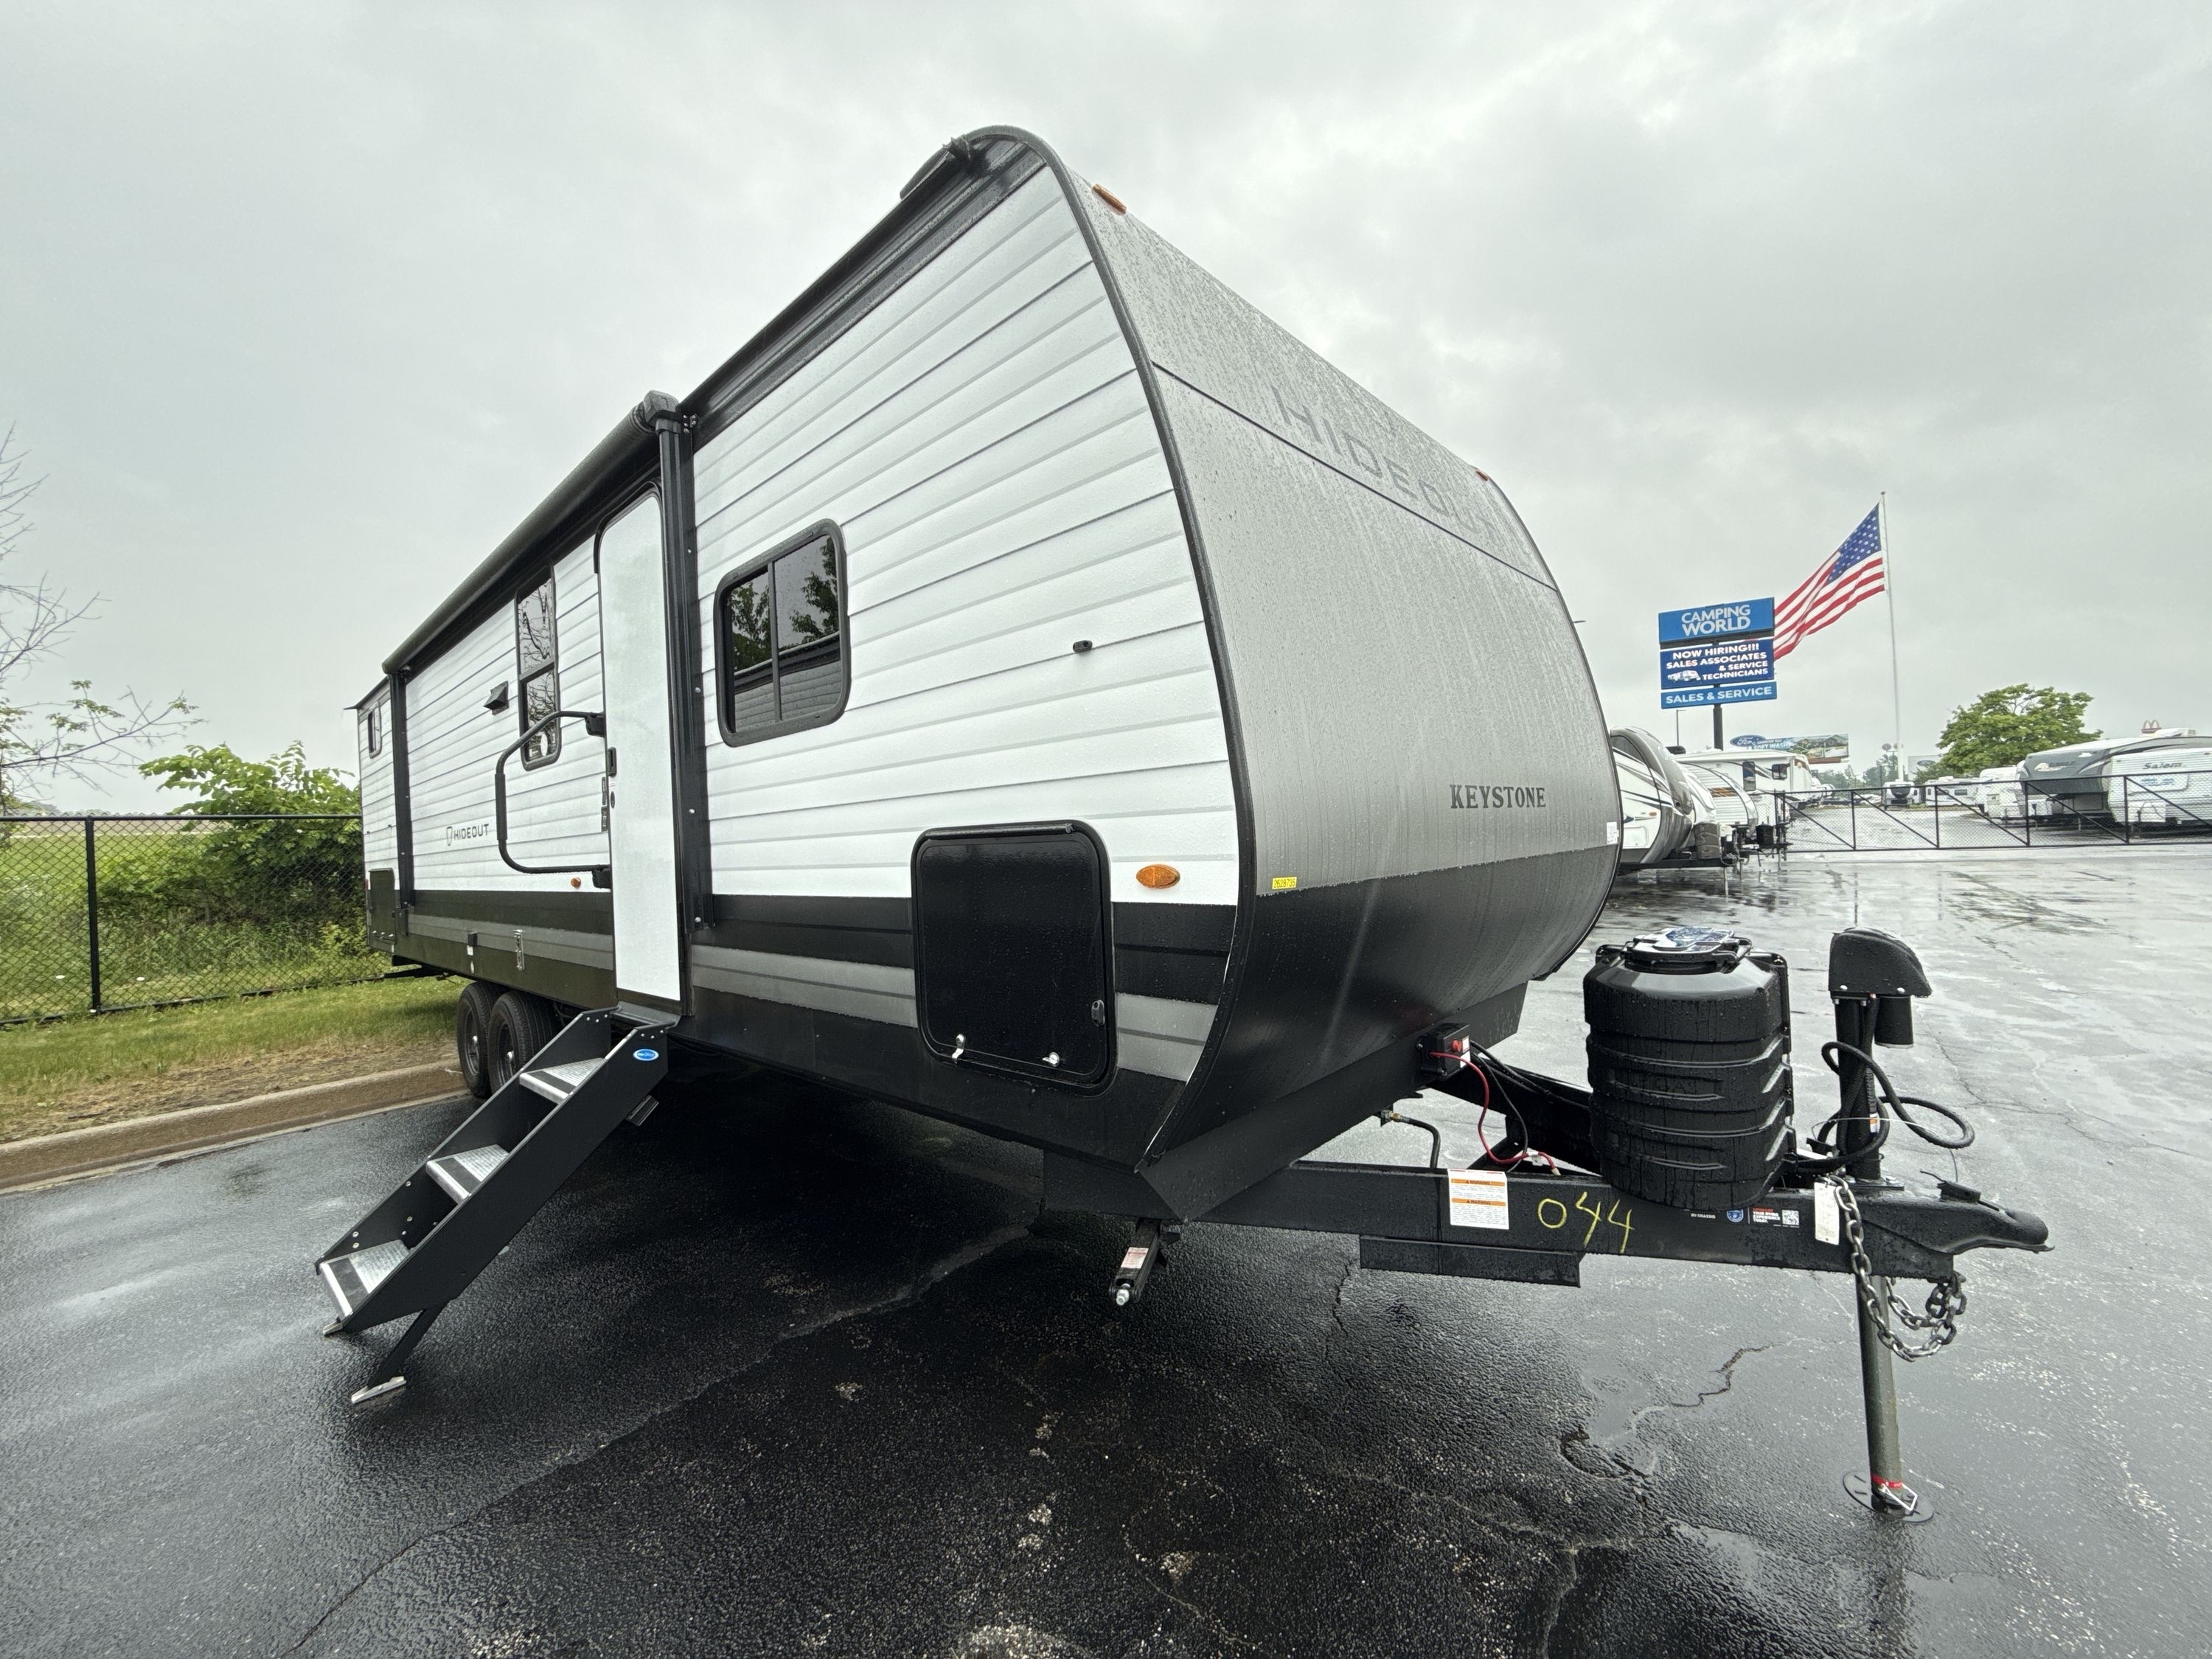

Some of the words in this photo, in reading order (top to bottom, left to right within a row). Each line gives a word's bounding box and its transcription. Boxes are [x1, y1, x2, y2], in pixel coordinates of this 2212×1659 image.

[1681, 604, 1751, 624] CAMPING
[1681, 616, 1751, 636] WORLD
[1672, 650, 1702, 660] NOW
[1705, 643, 1759, 656] HIRING!!!
[1666, 660, 1698, 669] SALES
[1700, 652, 1767, 666] ASSOCIATES
[1728, 661, 1768, 669] SERVICE
[1703, 668, 1769, 681] TECHNICIANS
[1666, 692, 1704, 704] SALES
[1706, 692, 1715, 700] &
[1717, 686, 1773, 699] SERVICE
[1450, 784, 1547, 809] KEYSTONE
[453, 824, 489, 841] HIDEOUT
